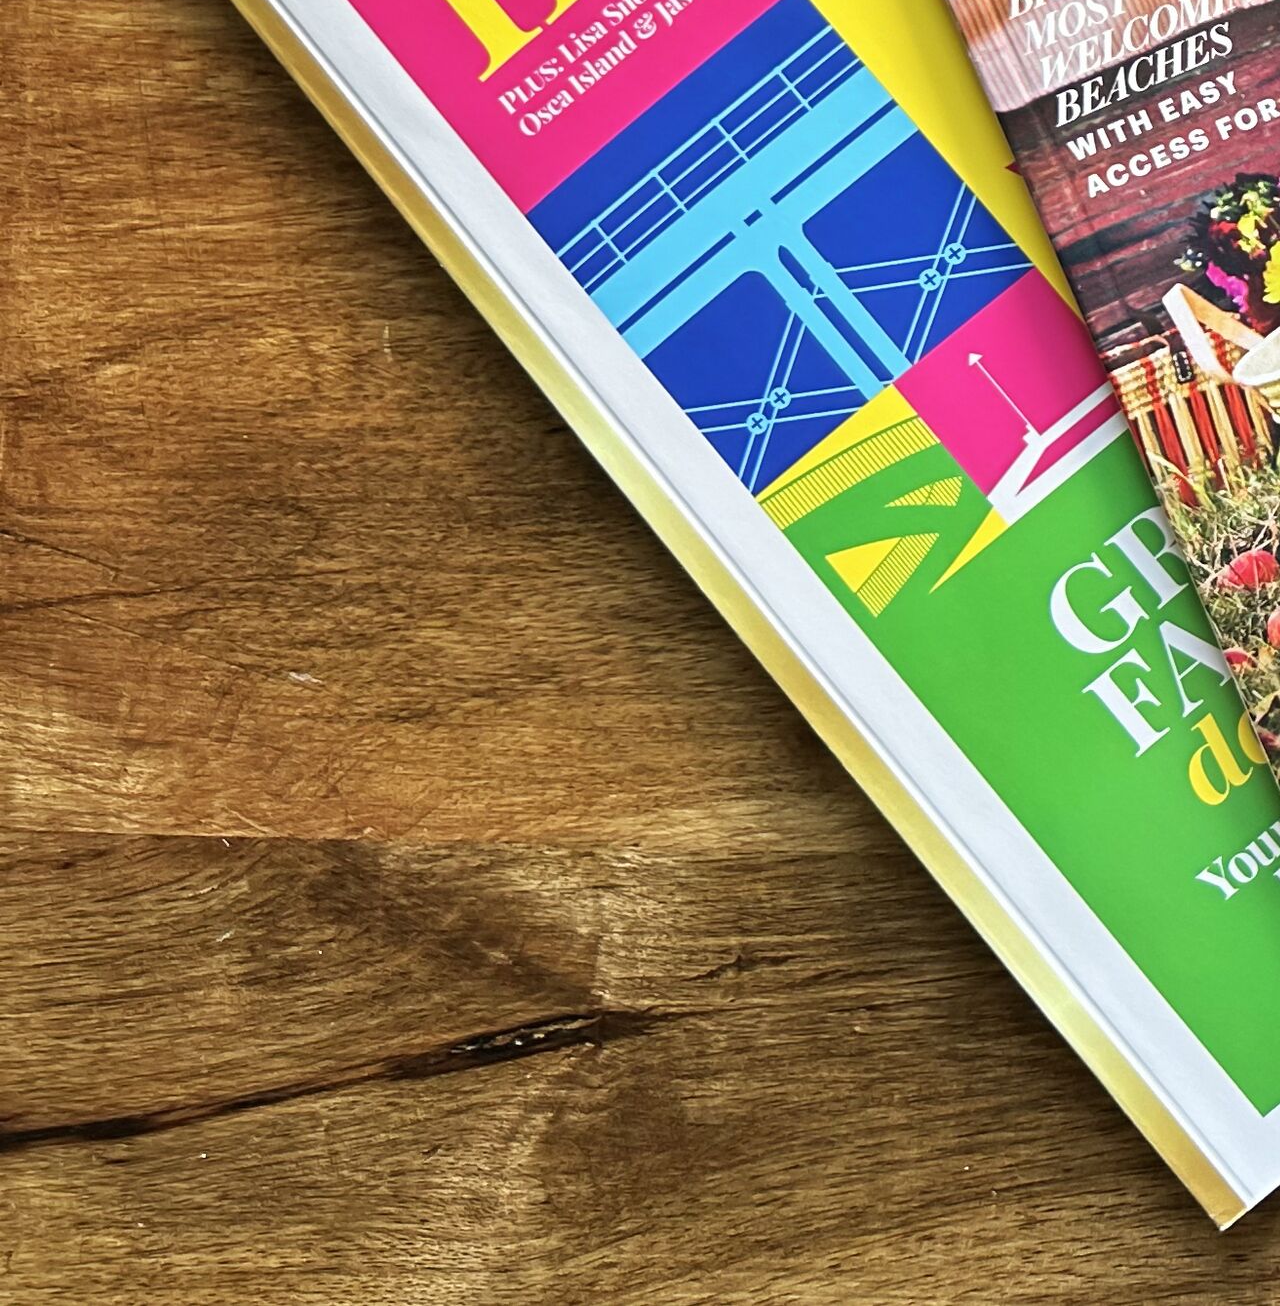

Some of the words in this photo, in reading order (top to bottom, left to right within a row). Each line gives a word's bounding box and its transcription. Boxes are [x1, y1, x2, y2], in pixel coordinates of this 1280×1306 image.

[498, 56, 565, 115] PLUS:
[557, 31, 609, 64] Lisa
[567, 30, 638, 94] Island
[632, 11, 658, 40] &
[1055, 21, 1235, 129] BEACHES
[1066, 108, 1156, 163] WITH
[1160, 70, 1241, 124] EASY
[1087, 130, 1210, 199] ACCESS
